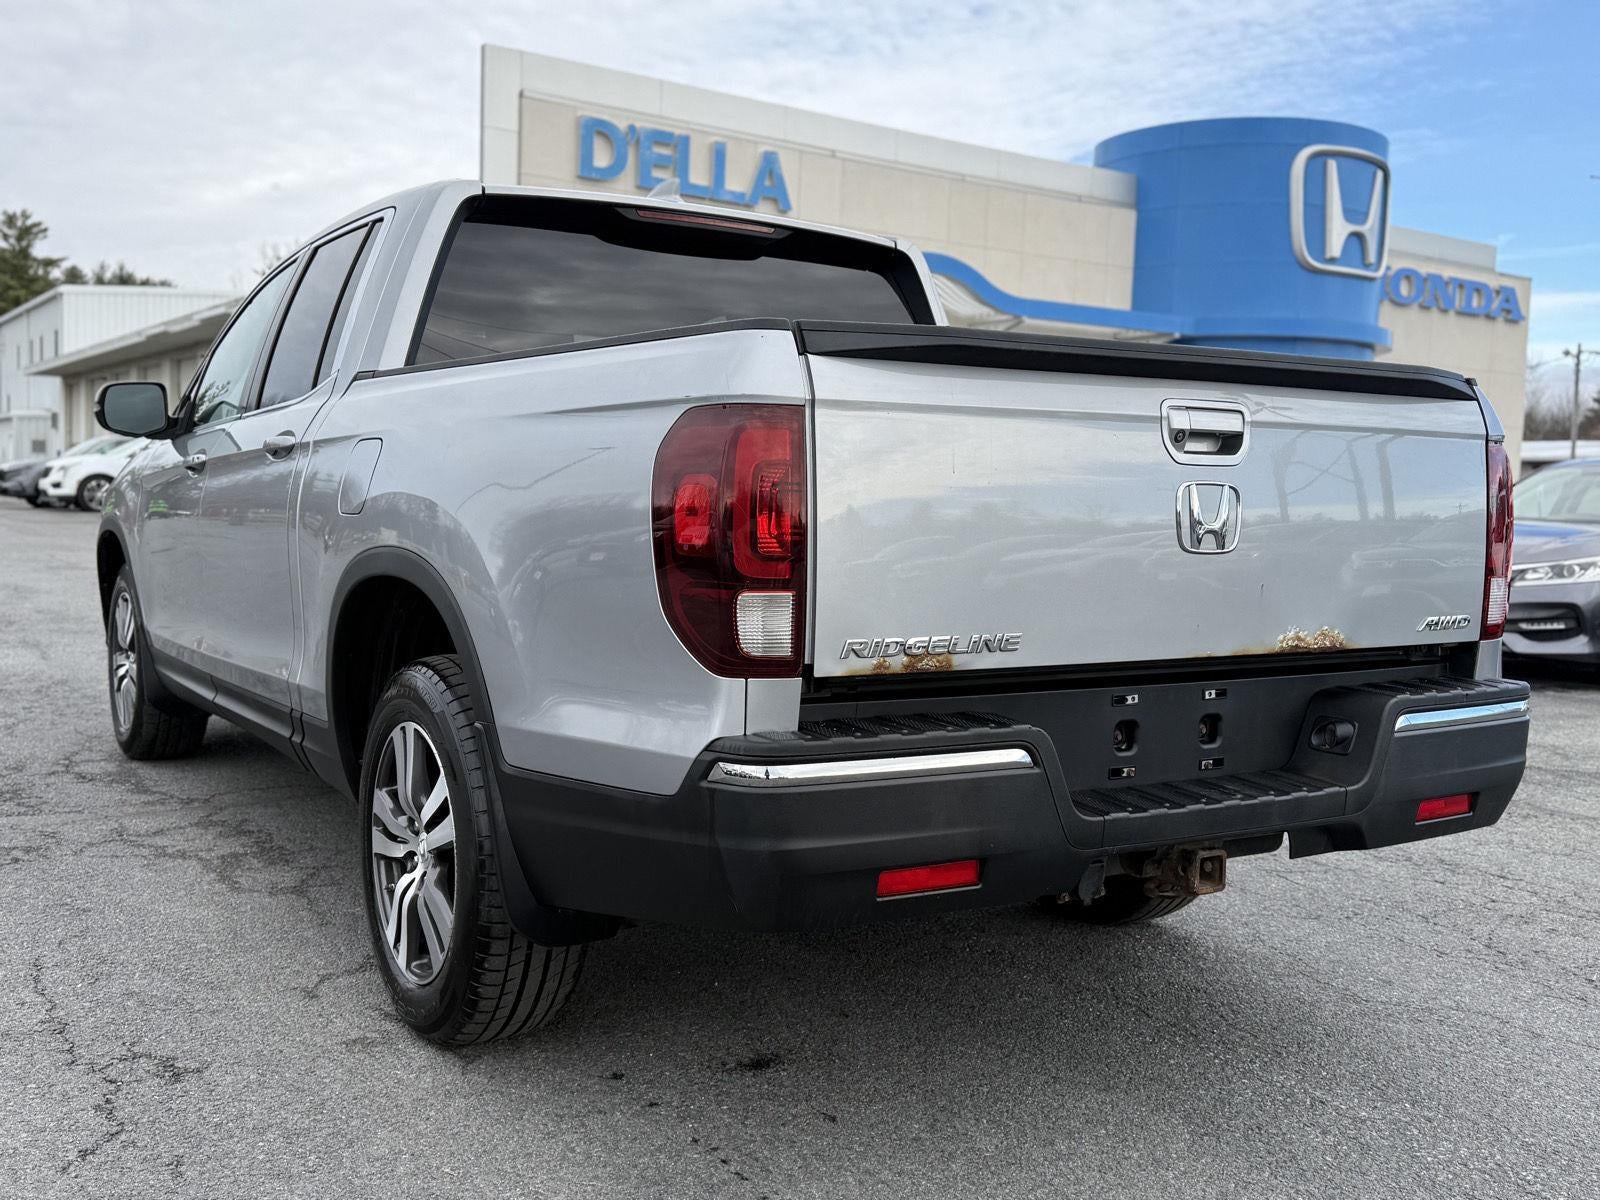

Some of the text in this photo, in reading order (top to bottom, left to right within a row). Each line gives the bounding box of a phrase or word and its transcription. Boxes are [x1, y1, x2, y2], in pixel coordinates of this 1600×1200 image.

[579, 115, 792, 213] D'ELLA
[1382, 266, 1525, 321] ONDA
[1416, 614, 1471, 632] AWD
[840, 632, 1023, 659] RIDGELINE
